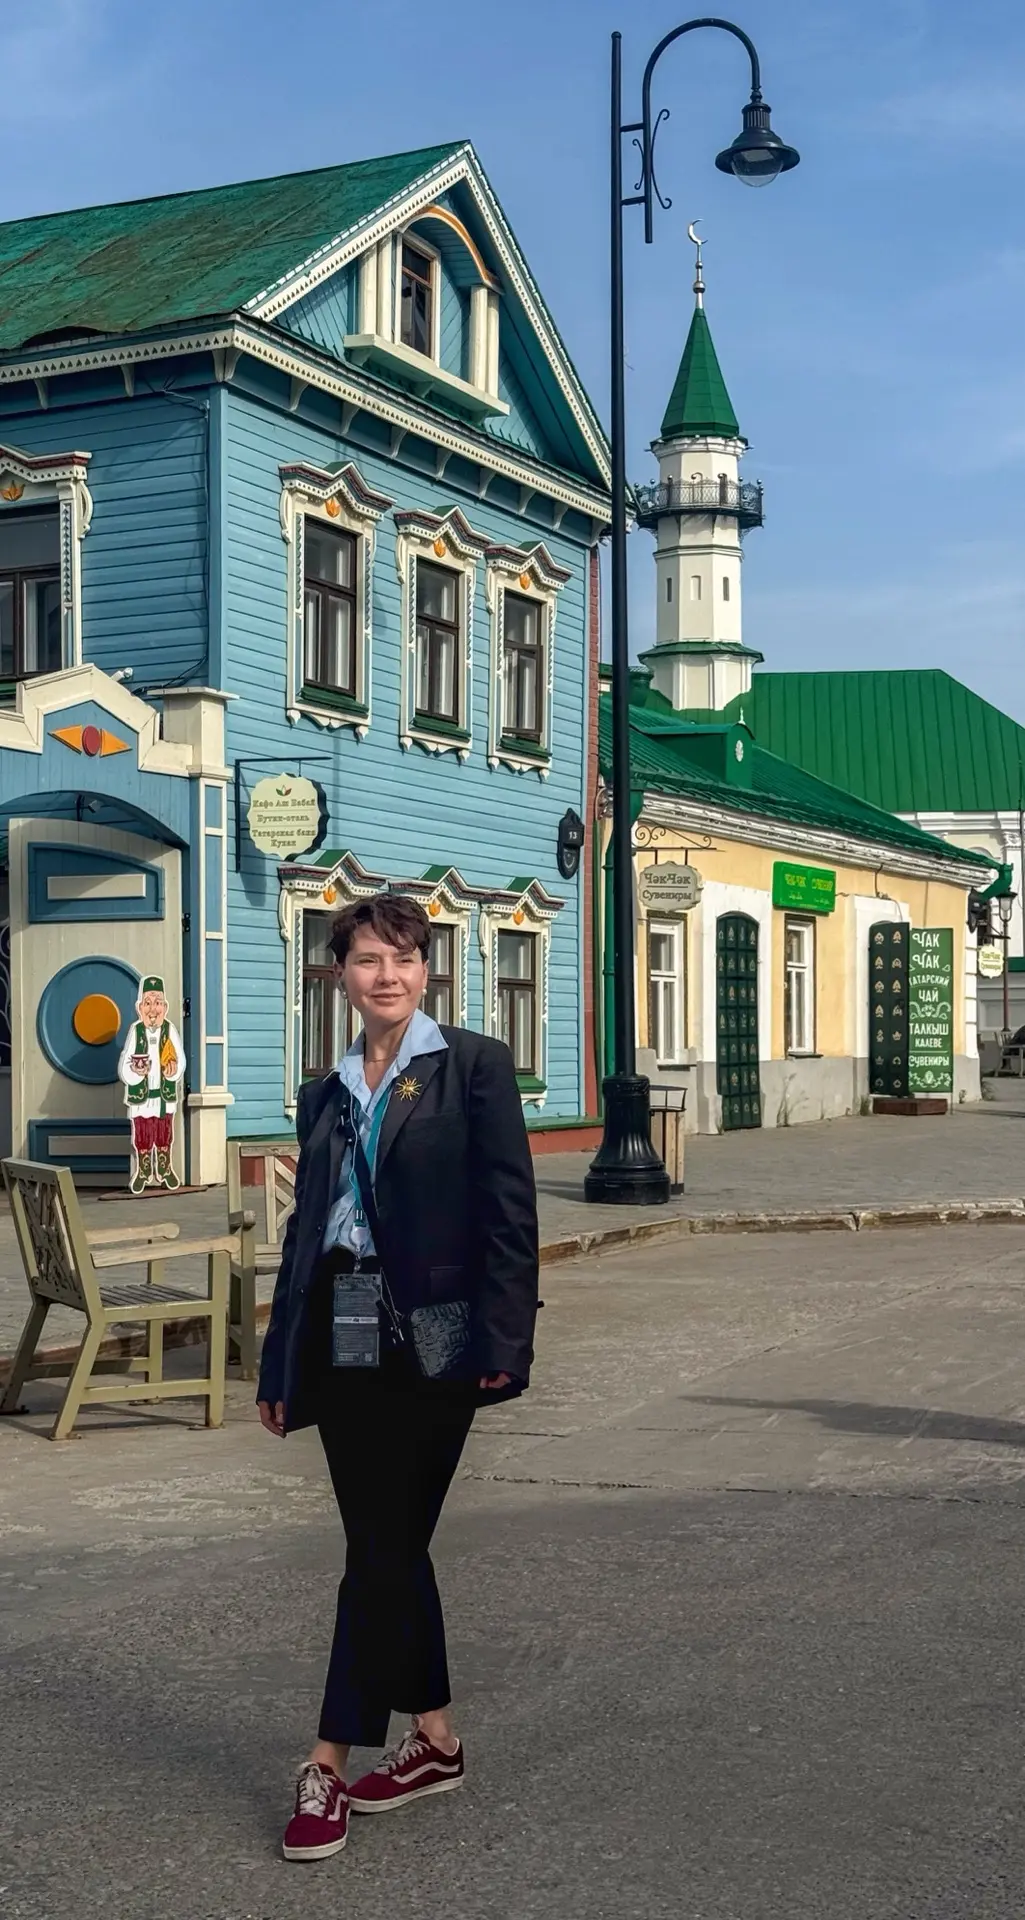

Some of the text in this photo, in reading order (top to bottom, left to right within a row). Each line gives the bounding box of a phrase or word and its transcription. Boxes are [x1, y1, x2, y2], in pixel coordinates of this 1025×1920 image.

[568, 831, 578, 839] 13
[642, 889, 693, 902] Сувениры
[912, 931, 940, 947] ЧАК
[912, 952, 940, 969] ЧАК
[918, 987, 939, 1002] ЧАЙ
[908, 1022, 949, 1035] ТАЛКЫШ
[914, 1038, 943, 1048] КАЛЕВЕ
[908, 1055, 950, 1067] СУВЕНИРЫ
